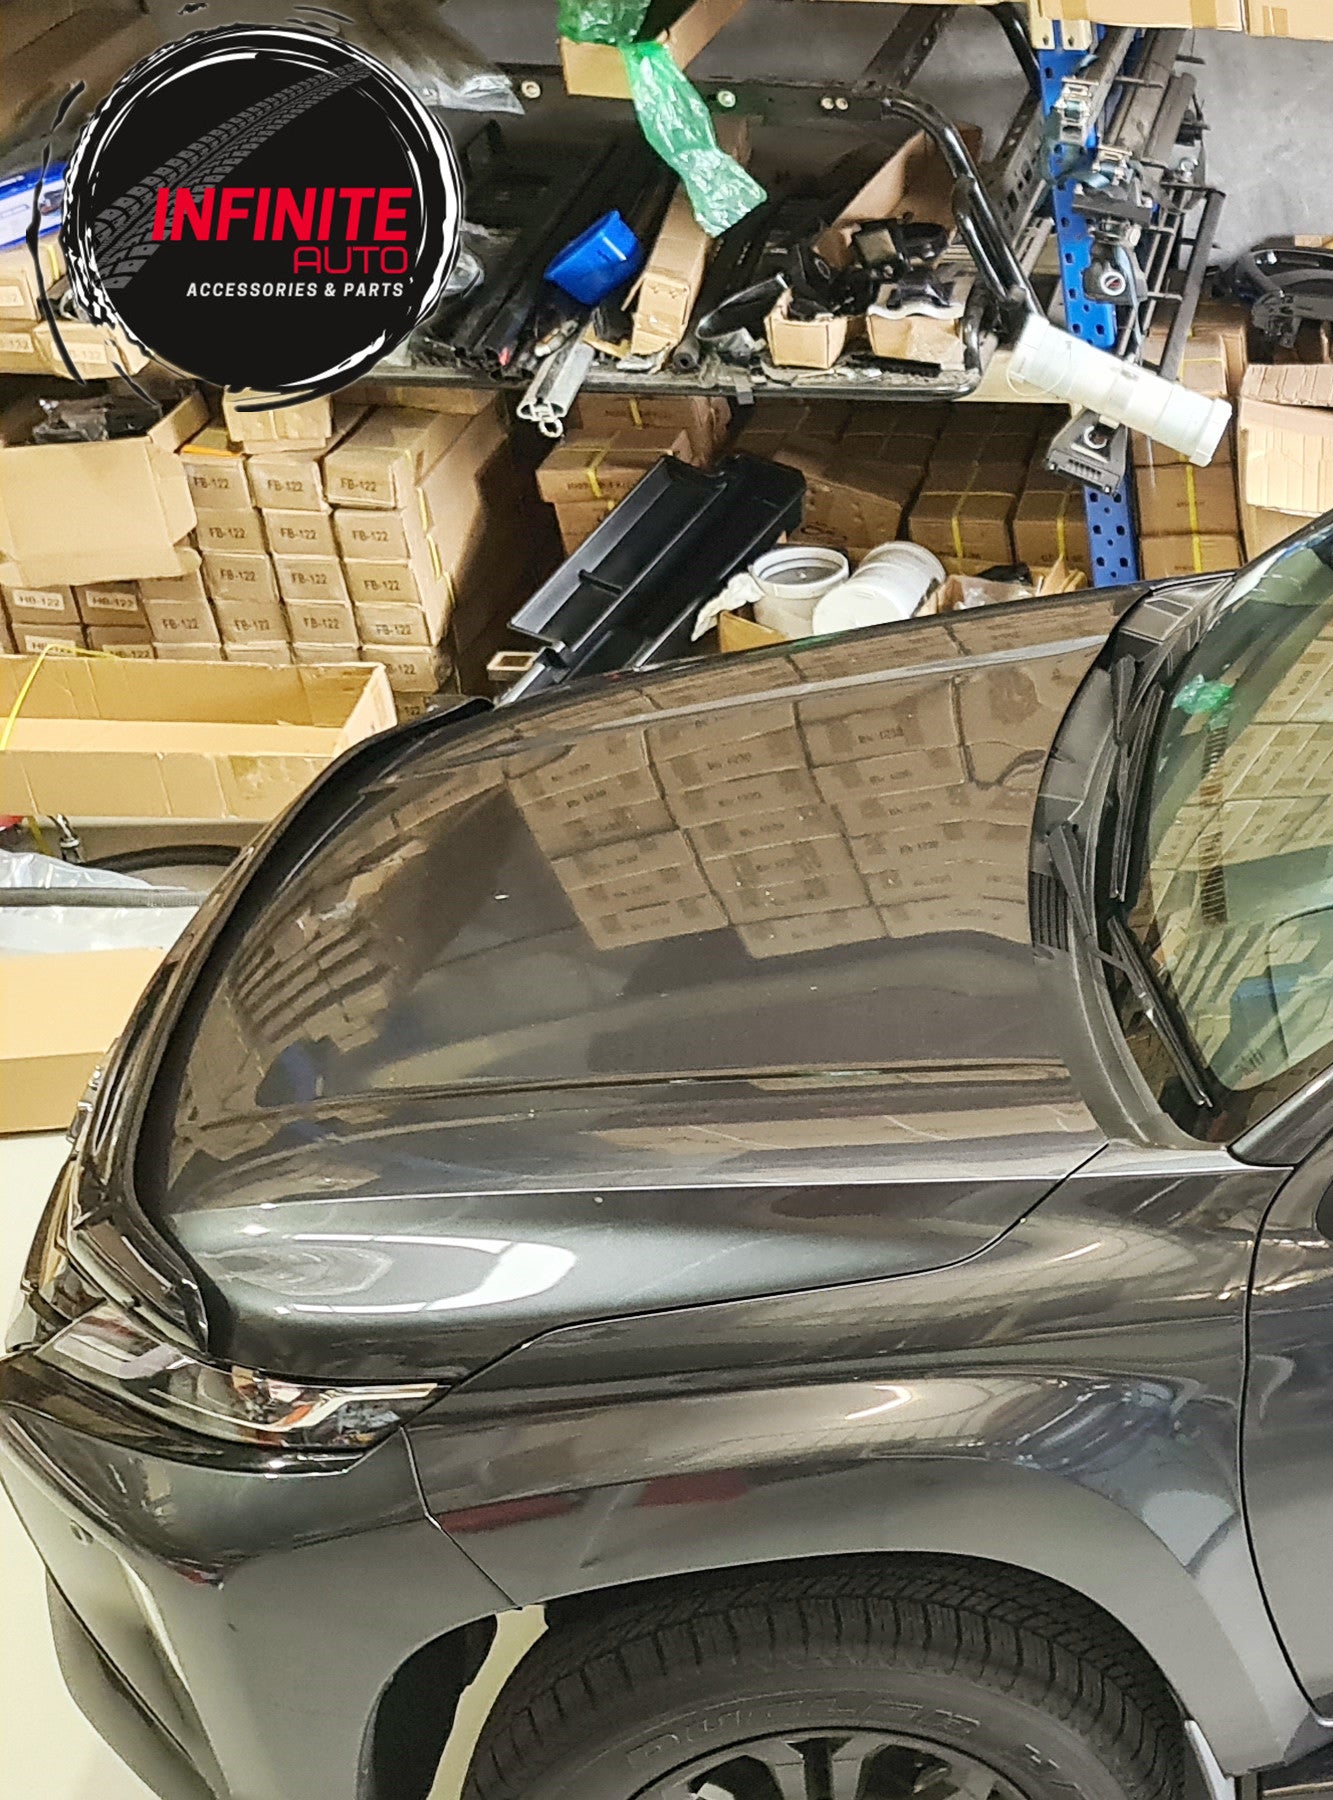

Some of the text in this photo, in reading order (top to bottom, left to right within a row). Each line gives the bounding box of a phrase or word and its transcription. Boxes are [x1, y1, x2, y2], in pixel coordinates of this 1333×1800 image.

[194, 477, 230, 489] FB-122
[267, 479, 304, 492] FB-122
[340, 478, 377, 492] FB-122
[209, 527, 246, 539] FB-122
[280, 527, 317, 540] FB-122
[351, 530, 389, 542] FB-122
[219, 570, 256, 582] FB-122
[291, 572, 328, 585] FB-122
[363, 579, 401, 591] FB-122
[162, 618, 200, 630] FB-122
[233, 619, 271, 631] FB-122
[302, 617, 340, 630] FB-122
[375, 623, 412, 636] FB-122
[387, 663, 416, 675] B-122
[403, 706, 421, 716] 122
